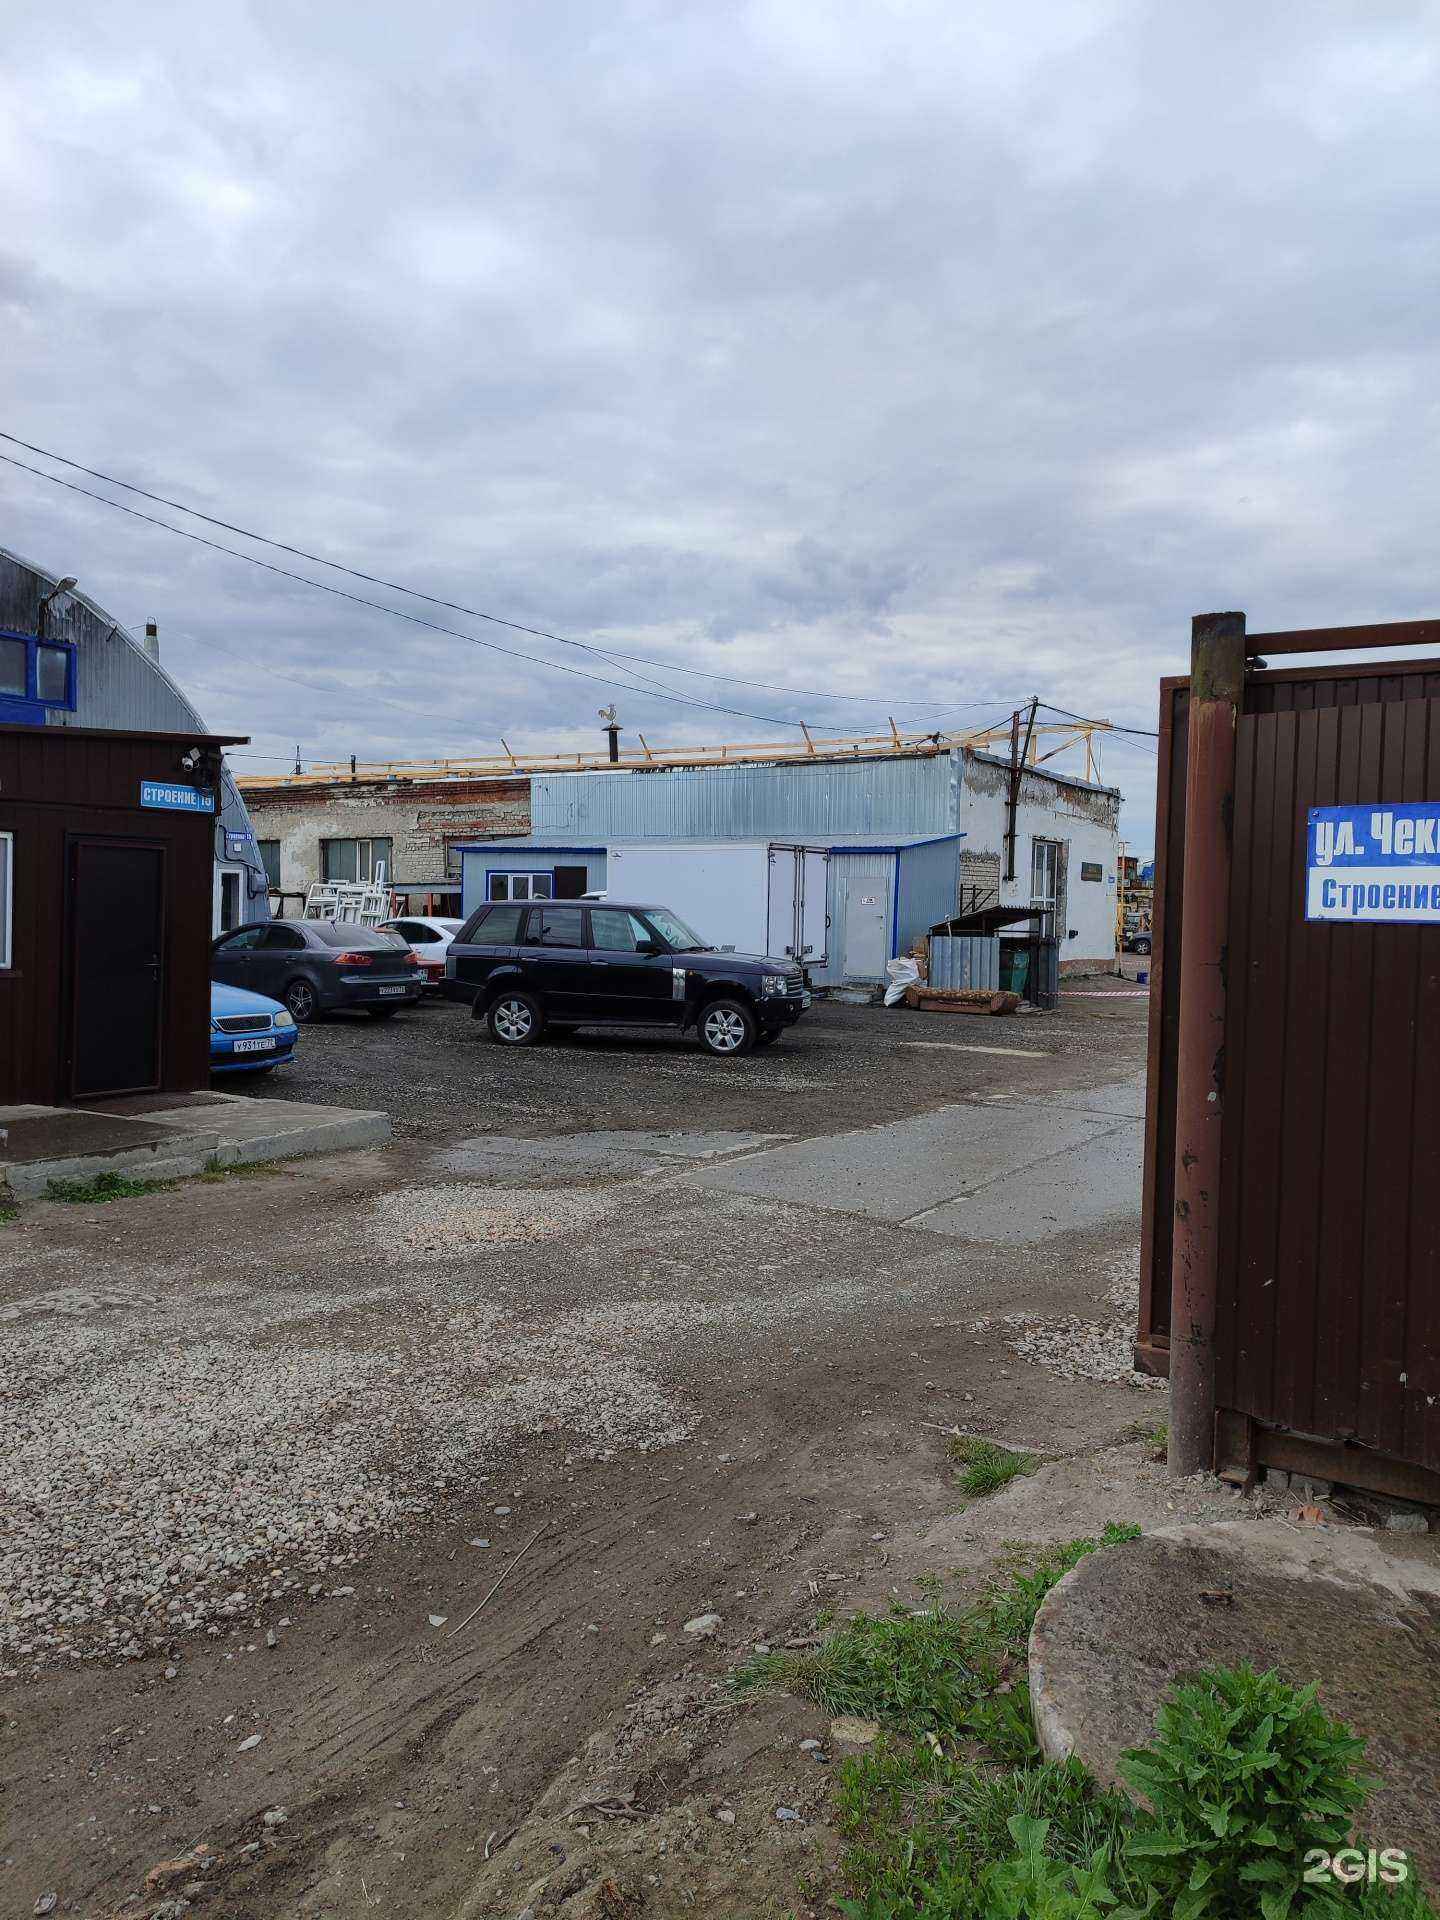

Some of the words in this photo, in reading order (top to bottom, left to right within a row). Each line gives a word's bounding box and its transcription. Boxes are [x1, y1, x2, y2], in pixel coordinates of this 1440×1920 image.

[143, 787, 197, 805] СТРОЕНИЕ
[1316, 821, 1365, 866] ул.
[1371, 812, 1440, 854] Чек
[1322, 879, 1440, 915] Строение
